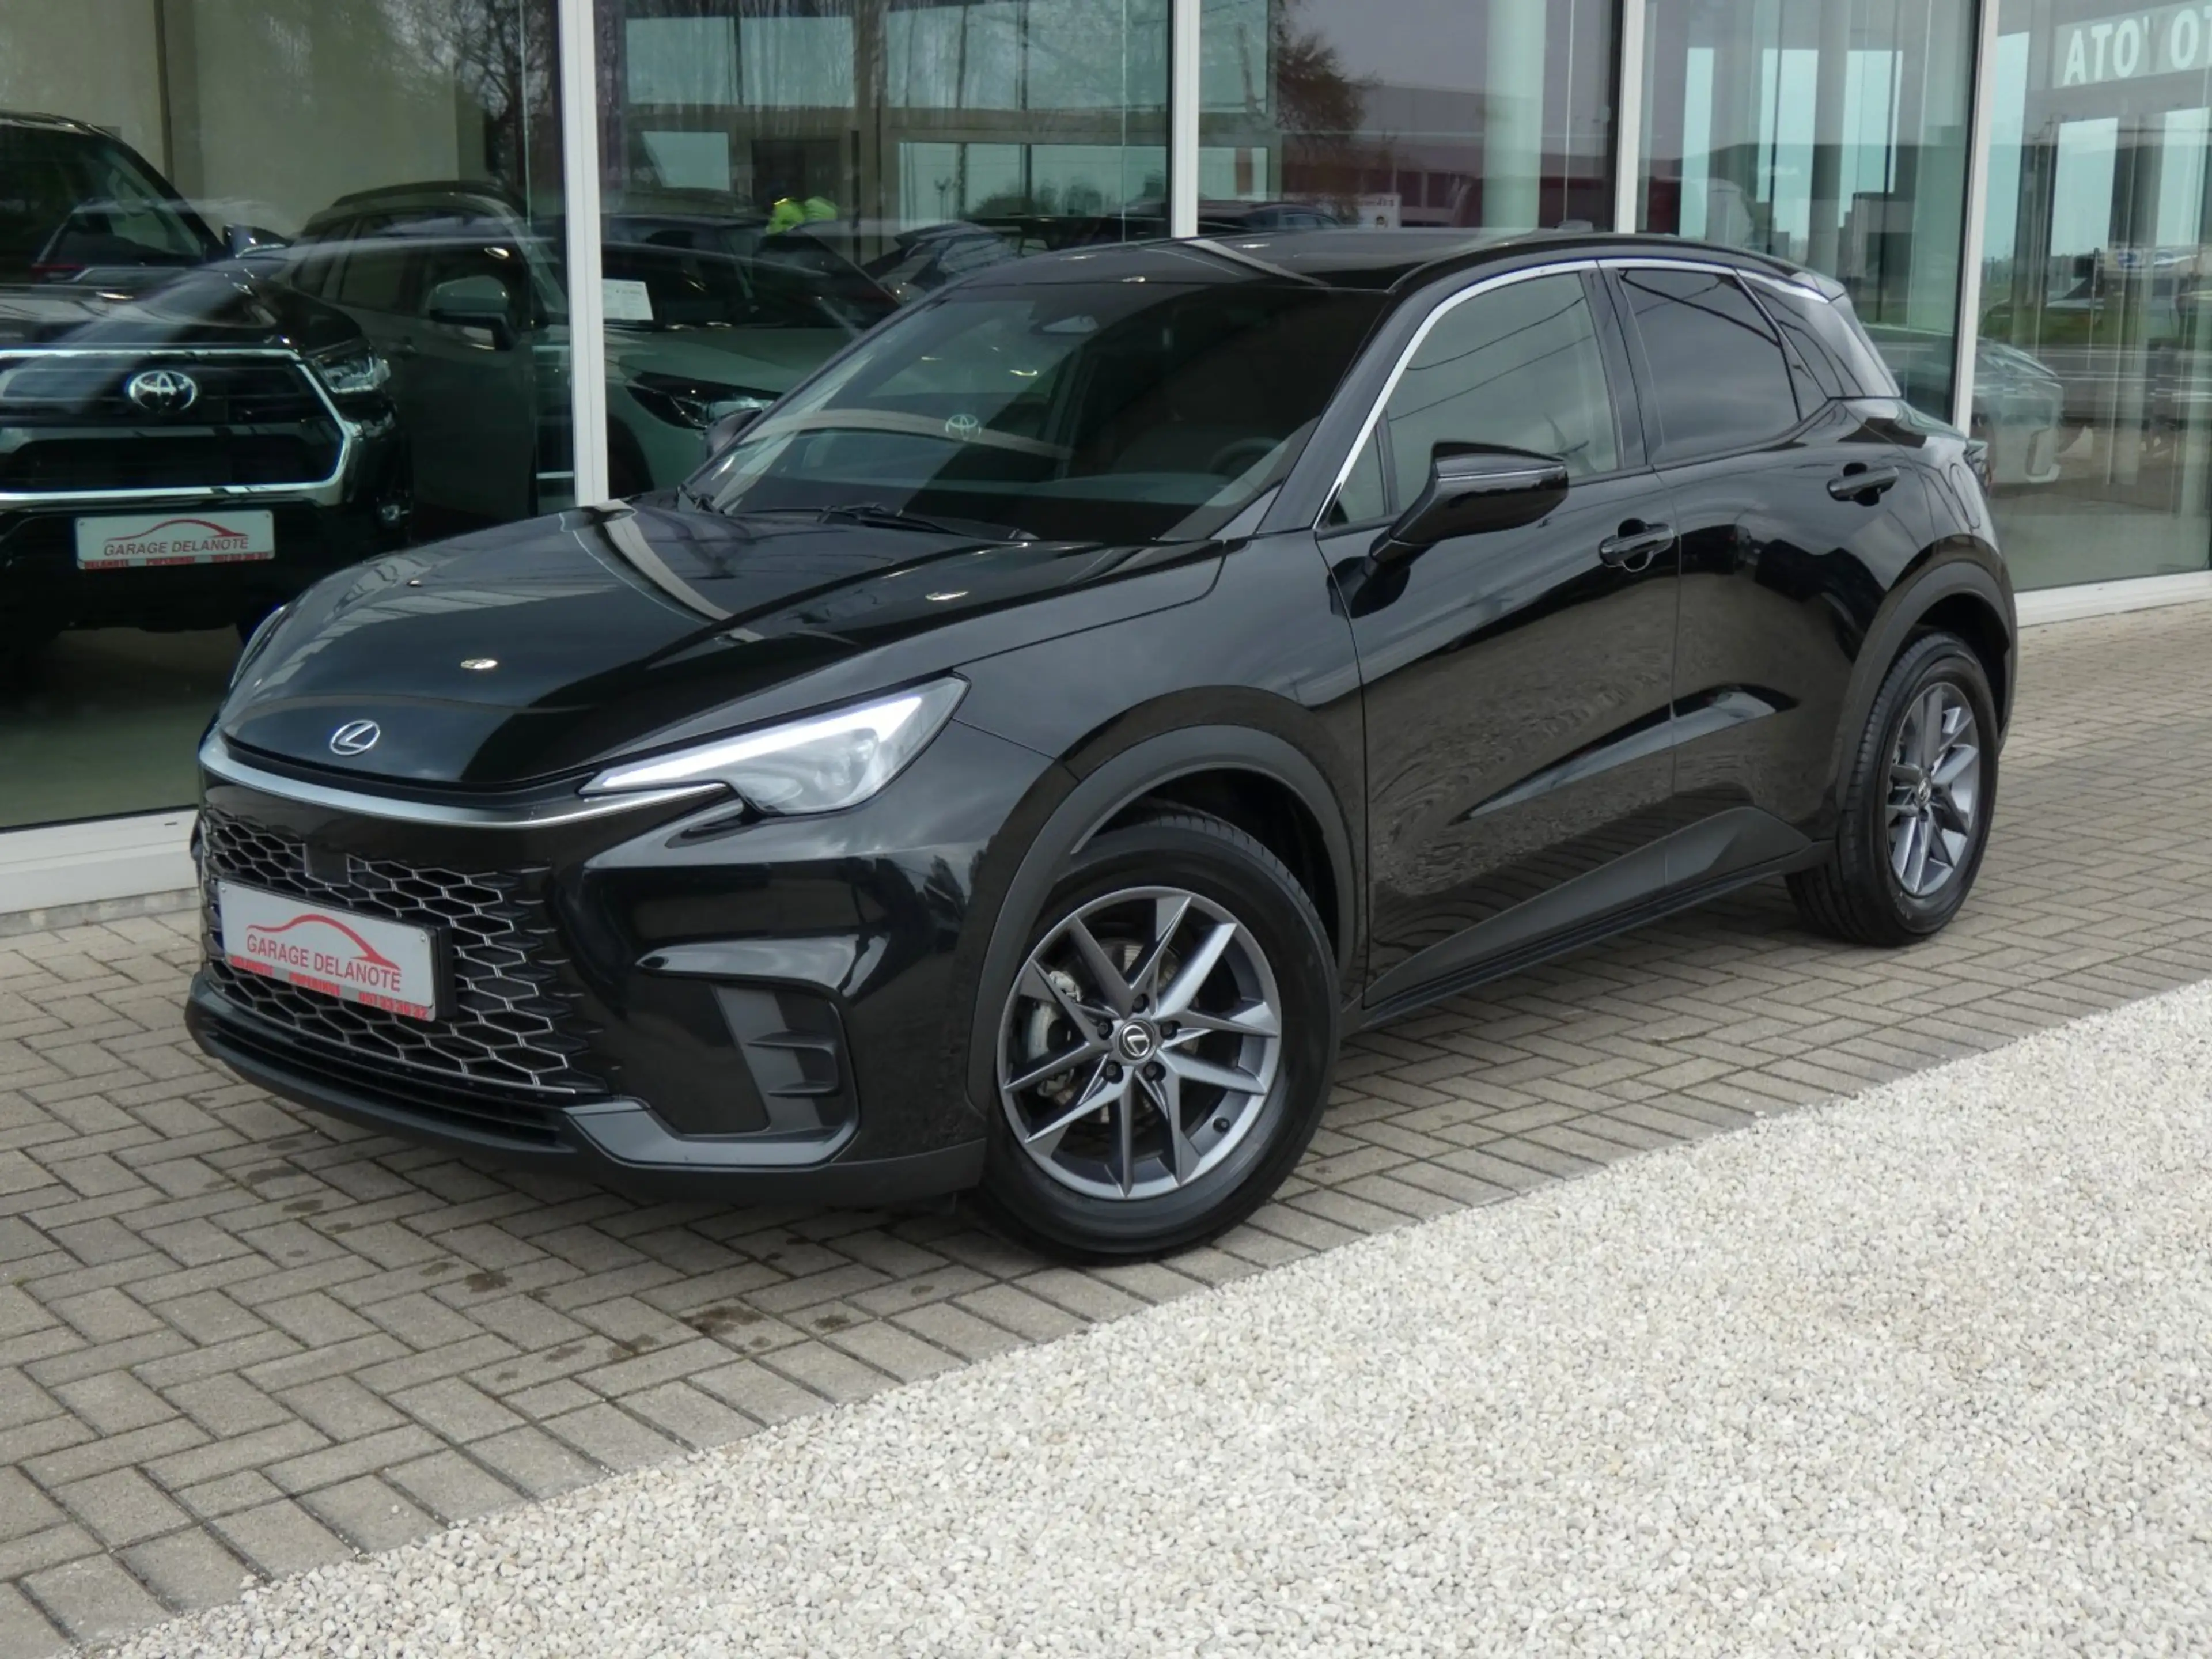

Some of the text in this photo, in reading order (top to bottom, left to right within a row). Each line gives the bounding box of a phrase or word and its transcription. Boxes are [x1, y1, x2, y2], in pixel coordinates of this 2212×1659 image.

[104, 537, 248, 556] GARAGE DELANOTE
[246, 933, 402, 992] GARAGE DELANOTE
